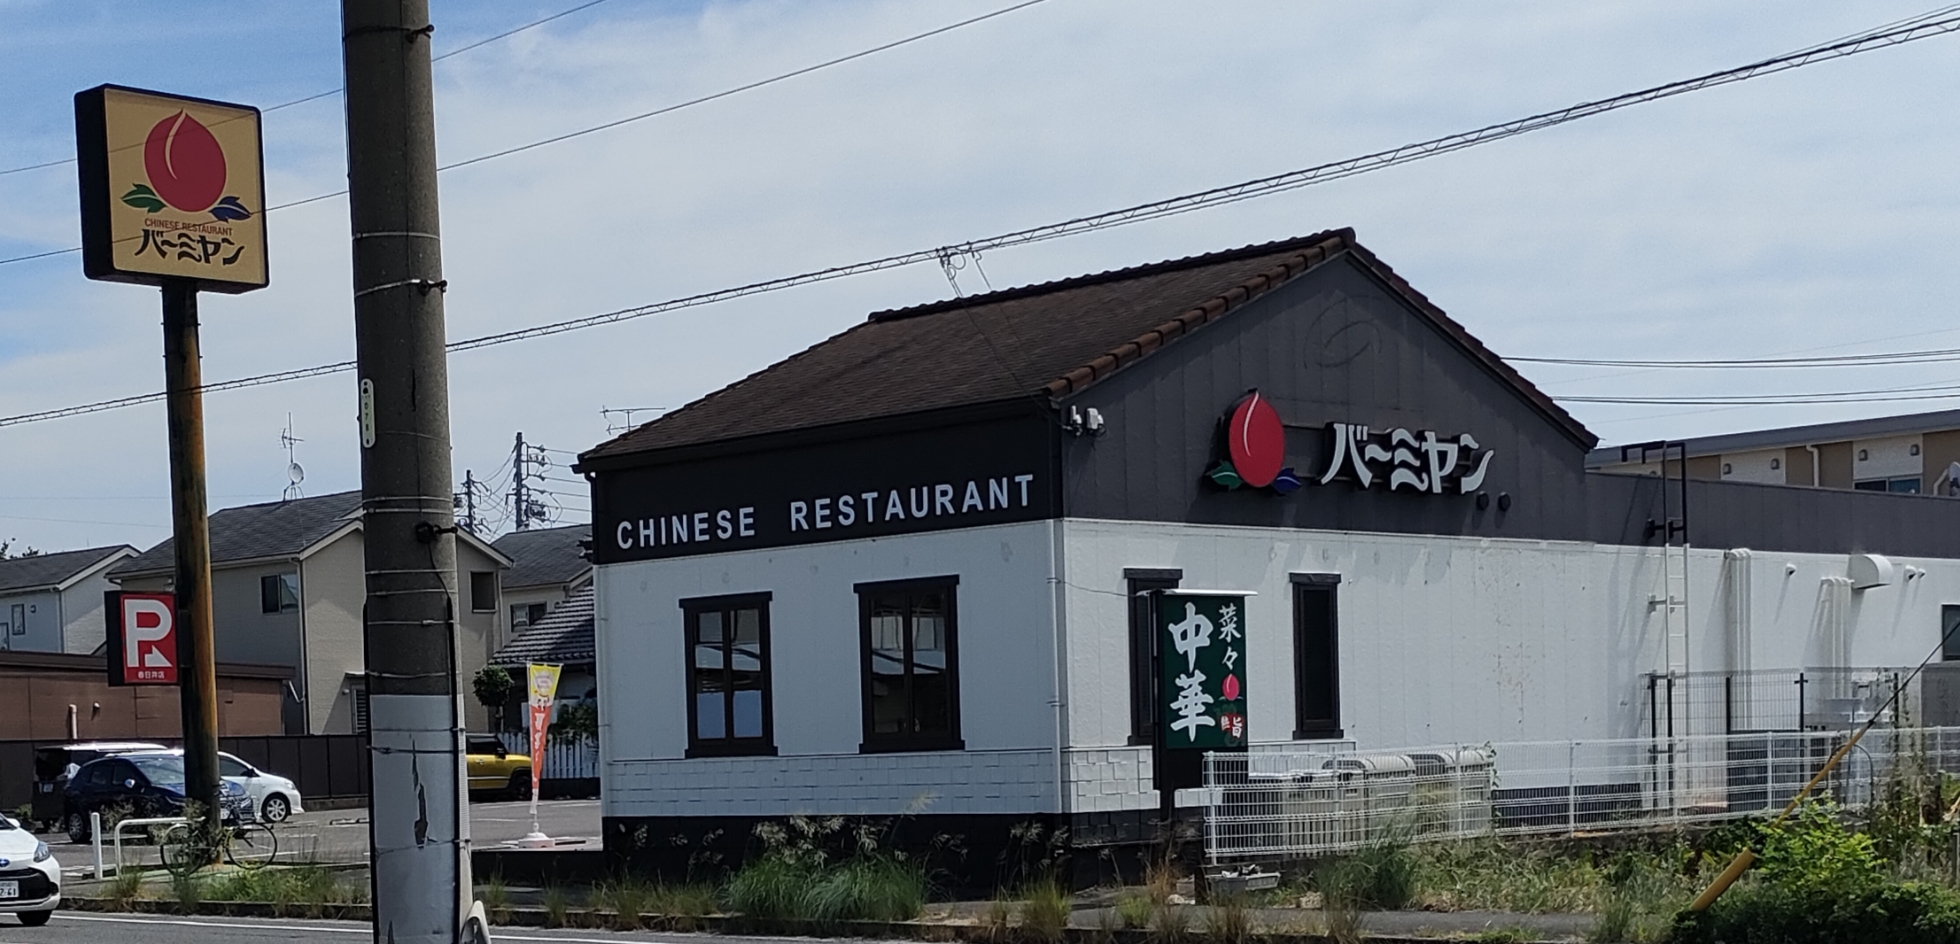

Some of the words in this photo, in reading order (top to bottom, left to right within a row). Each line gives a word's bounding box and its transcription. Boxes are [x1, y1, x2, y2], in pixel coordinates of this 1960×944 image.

[134, 228, 245, 266] バーミヤン
[144, 218, 180, 230] CHINESE
[181, 222, 233, 237] RESTAURANT
[1321, 423, 1494, 495] バーミヤン
[616, 506, 755, 550] CHINESE
[790, 474, 1034, 532] RESTAURANT
[124, 599, 173, 668] P
[1218, 602, 1242, 671] 菜々
[1167, 601, 1216, 743] 中華
